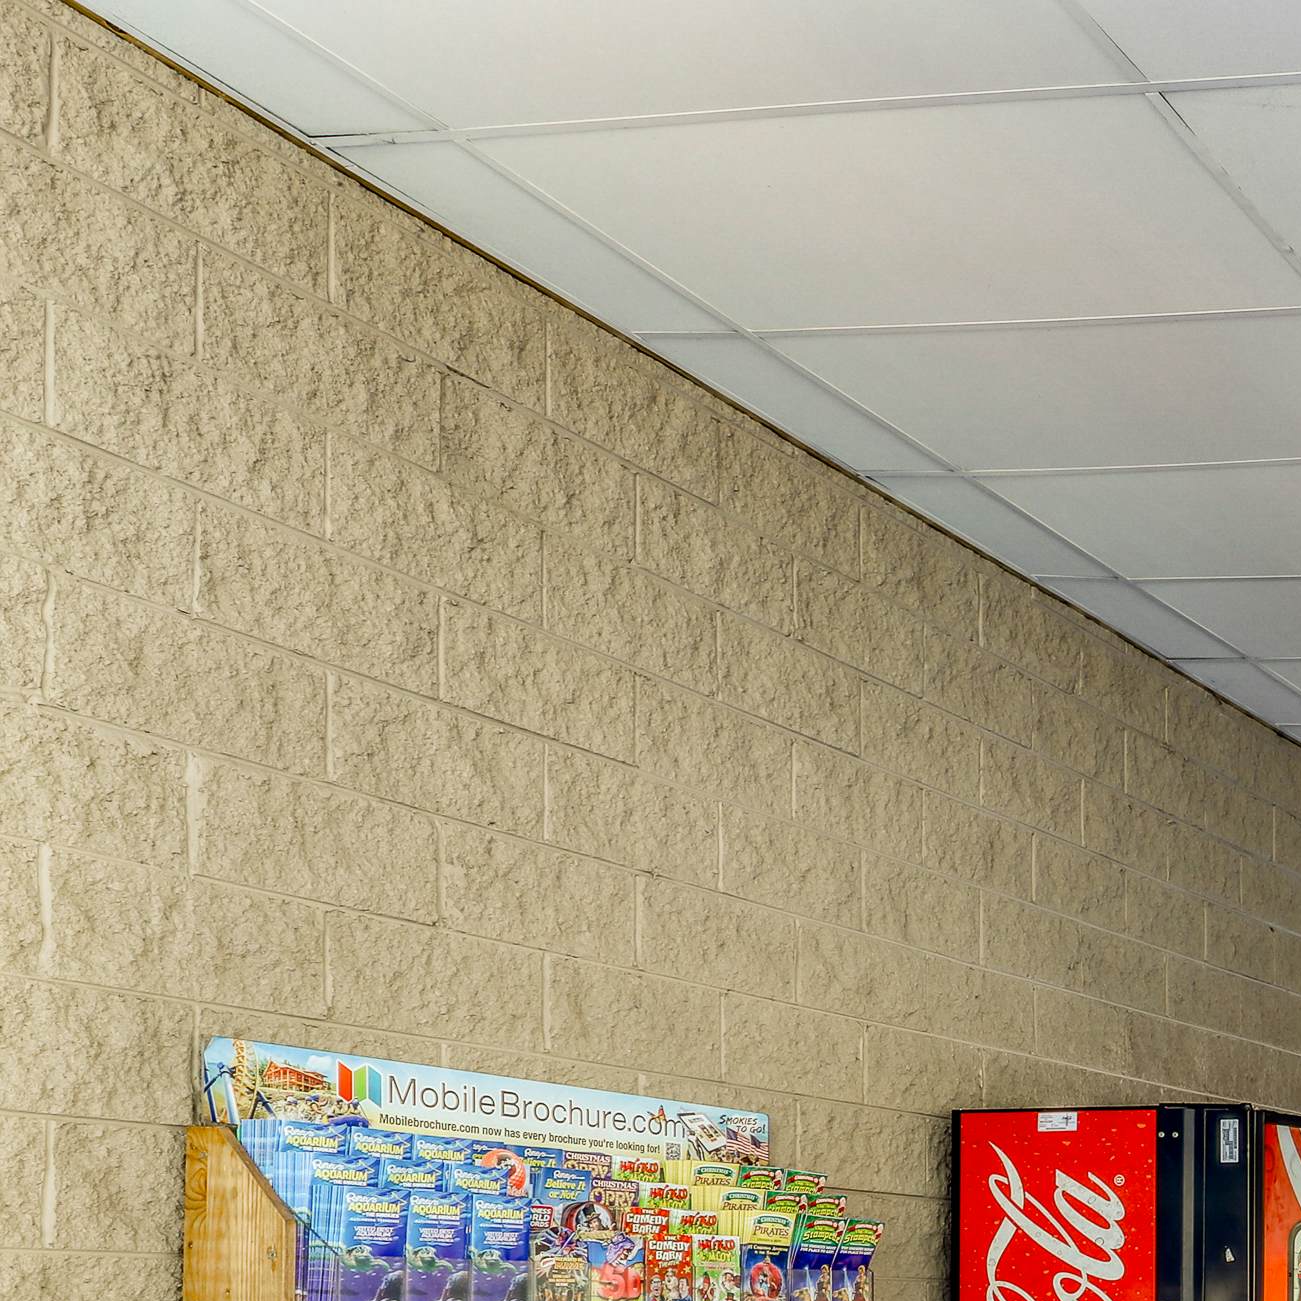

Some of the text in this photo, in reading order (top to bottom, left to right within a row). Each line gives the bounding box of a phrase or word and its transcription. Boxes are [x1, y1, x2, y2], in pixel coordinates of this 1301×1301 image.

[388, 1074, 686, 1139] MobileBrochure.com
[719, 1115, 758, 1126] SMOKIES
[379, 1113, 661, 1154] Mobilebrochure.com now has every brochure you're looking for!
[736, 1124, 766, 1135] TO GO!
[286, 1135, 338, 1148] AQUARIUM
[355, 1142, 404, 1155] AQUARIUM
[315, 1168, 368, 1182] AQUARIUM
[592, 1180, 637, 1191] CHRISTMAS
[348, 1201, 401, 1214] AQUARIUM
[412, 1203, 461, 1216] AQUARIUM
[477, 1207, 524, 1220] AQUARIUM
[626, 1214, 668, 1225] COMEDY
[632, 1223, 660, 1234] BARN
[753, 1225, 789, 1237] PIRATES
[649, 1240, 690, 1252] COMEDY
[655, 1250, 683, 1261] BARN
